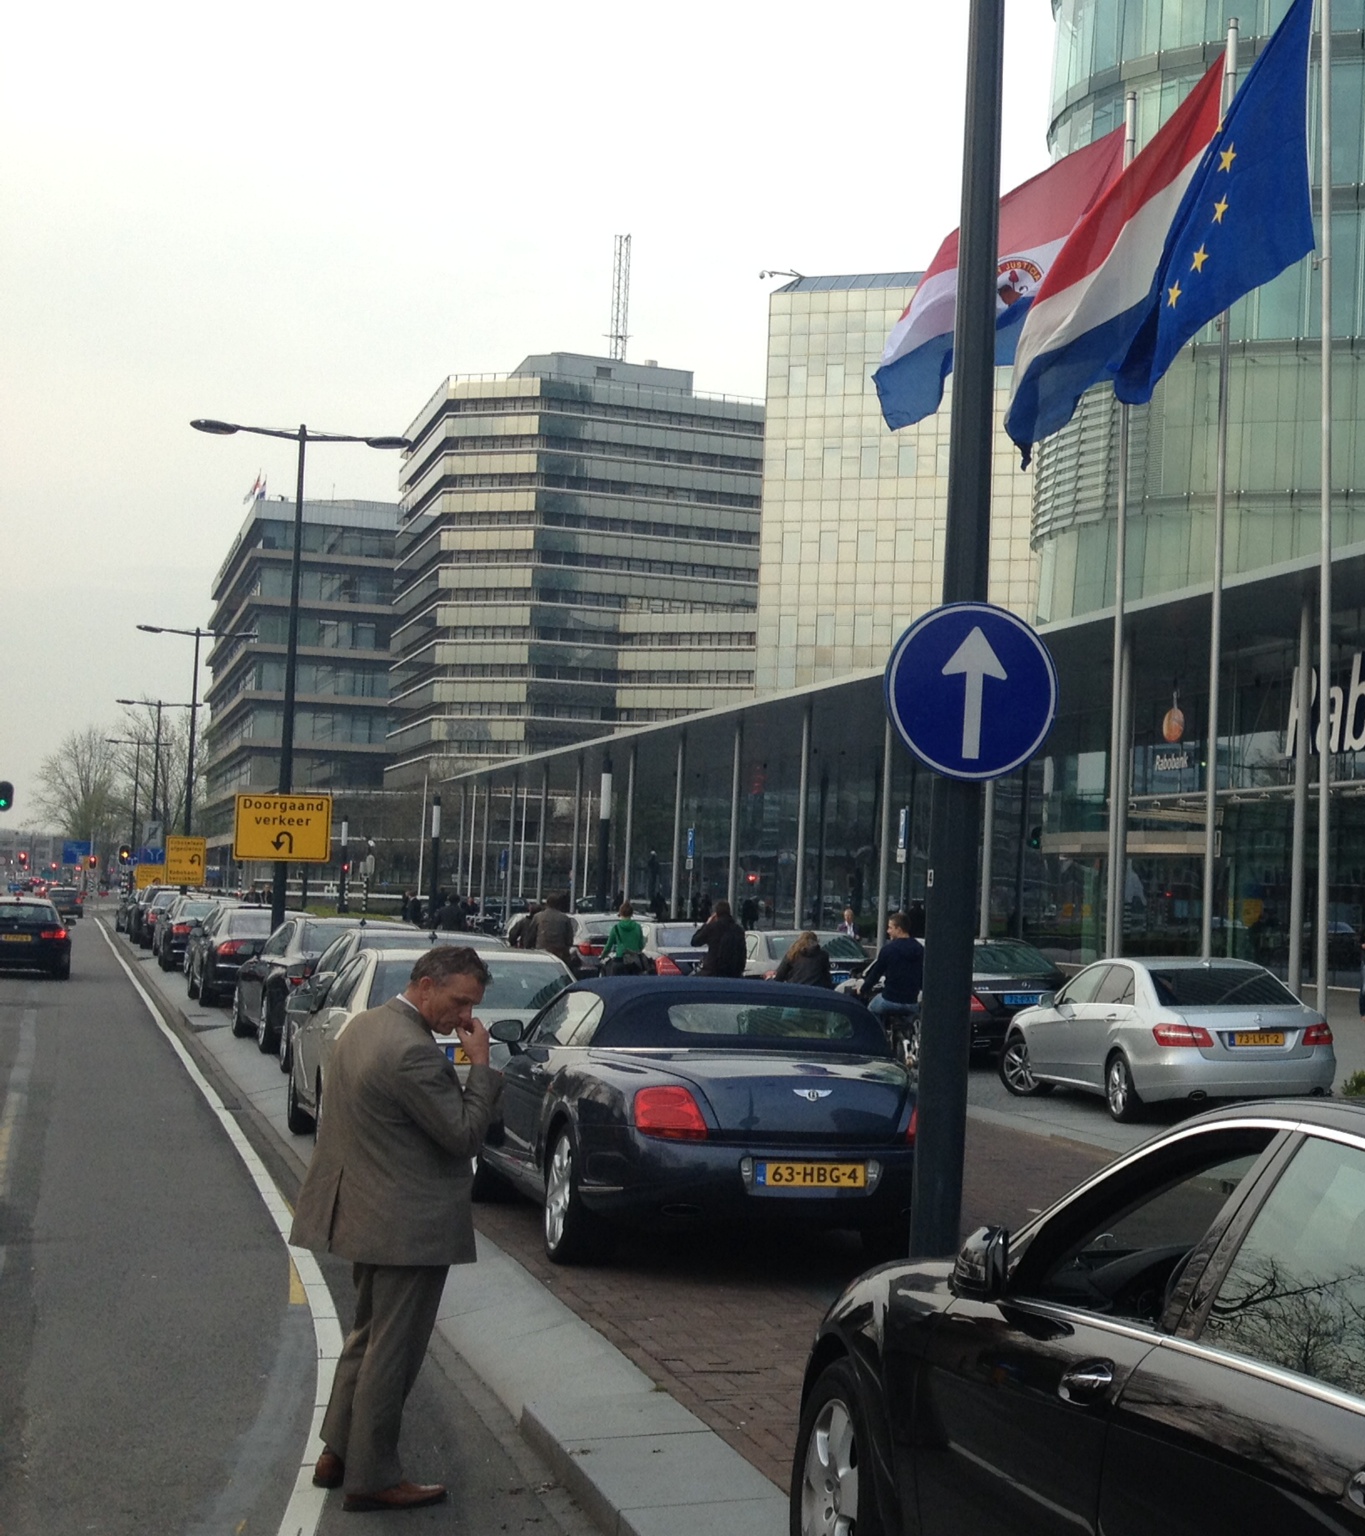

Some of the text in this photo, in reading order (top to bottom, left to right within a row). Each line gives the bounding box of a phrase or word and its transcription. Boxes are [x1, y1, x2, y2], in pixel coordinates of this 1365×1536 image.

[1005, 261, 1041, 281] JUSTICIA
[1155, 752, 1188, 771] Rabobank
[243, 798, 324, 813] Doorgaand
[254, 815, 312, 826] verkeer
[1238, 1034, 1280, 1044] 73-LHT-2
[772, 1166, 858, 1184] 63-HBG-4
